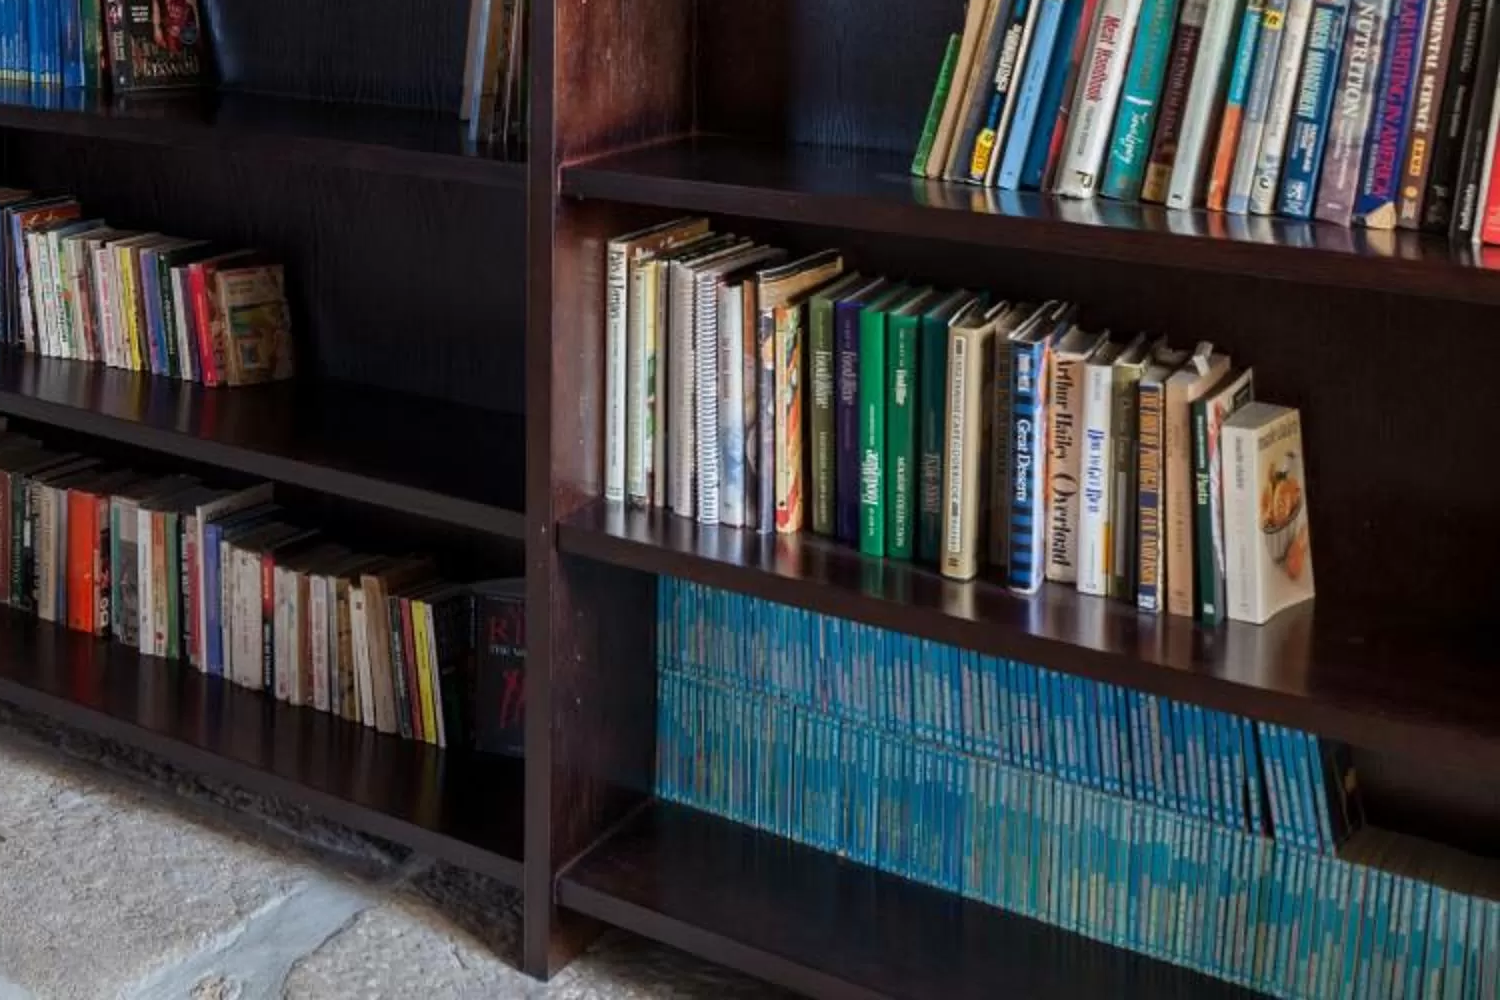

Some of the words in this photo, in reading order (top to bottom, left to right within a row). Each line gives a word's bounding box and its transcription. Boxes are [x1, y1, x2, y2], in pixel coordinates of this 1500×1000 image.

[1100, 15, 1122, 45] Meat
[1085, 47, 1119, 104] Handbook
[1341, 1, 1376, 117] NUTRITION
[1387, 34, 1415, 101] WRITING
[1385, 102, 1406, 123] IN
[1413, 73, 1438, 133] SCIENCE
[1373, 122, 1402, 200] AMERICA
[1054, 357, 1075, 409] Arthur
[1016, 419, 1030, 452] Great
[1049, 411, 1075, 460] Hailey
[1015, 453, 1030, 503] Desserts
[1195, 473, 1211, 505] Pasta
[1051, 472, 1077, 567] Overload
